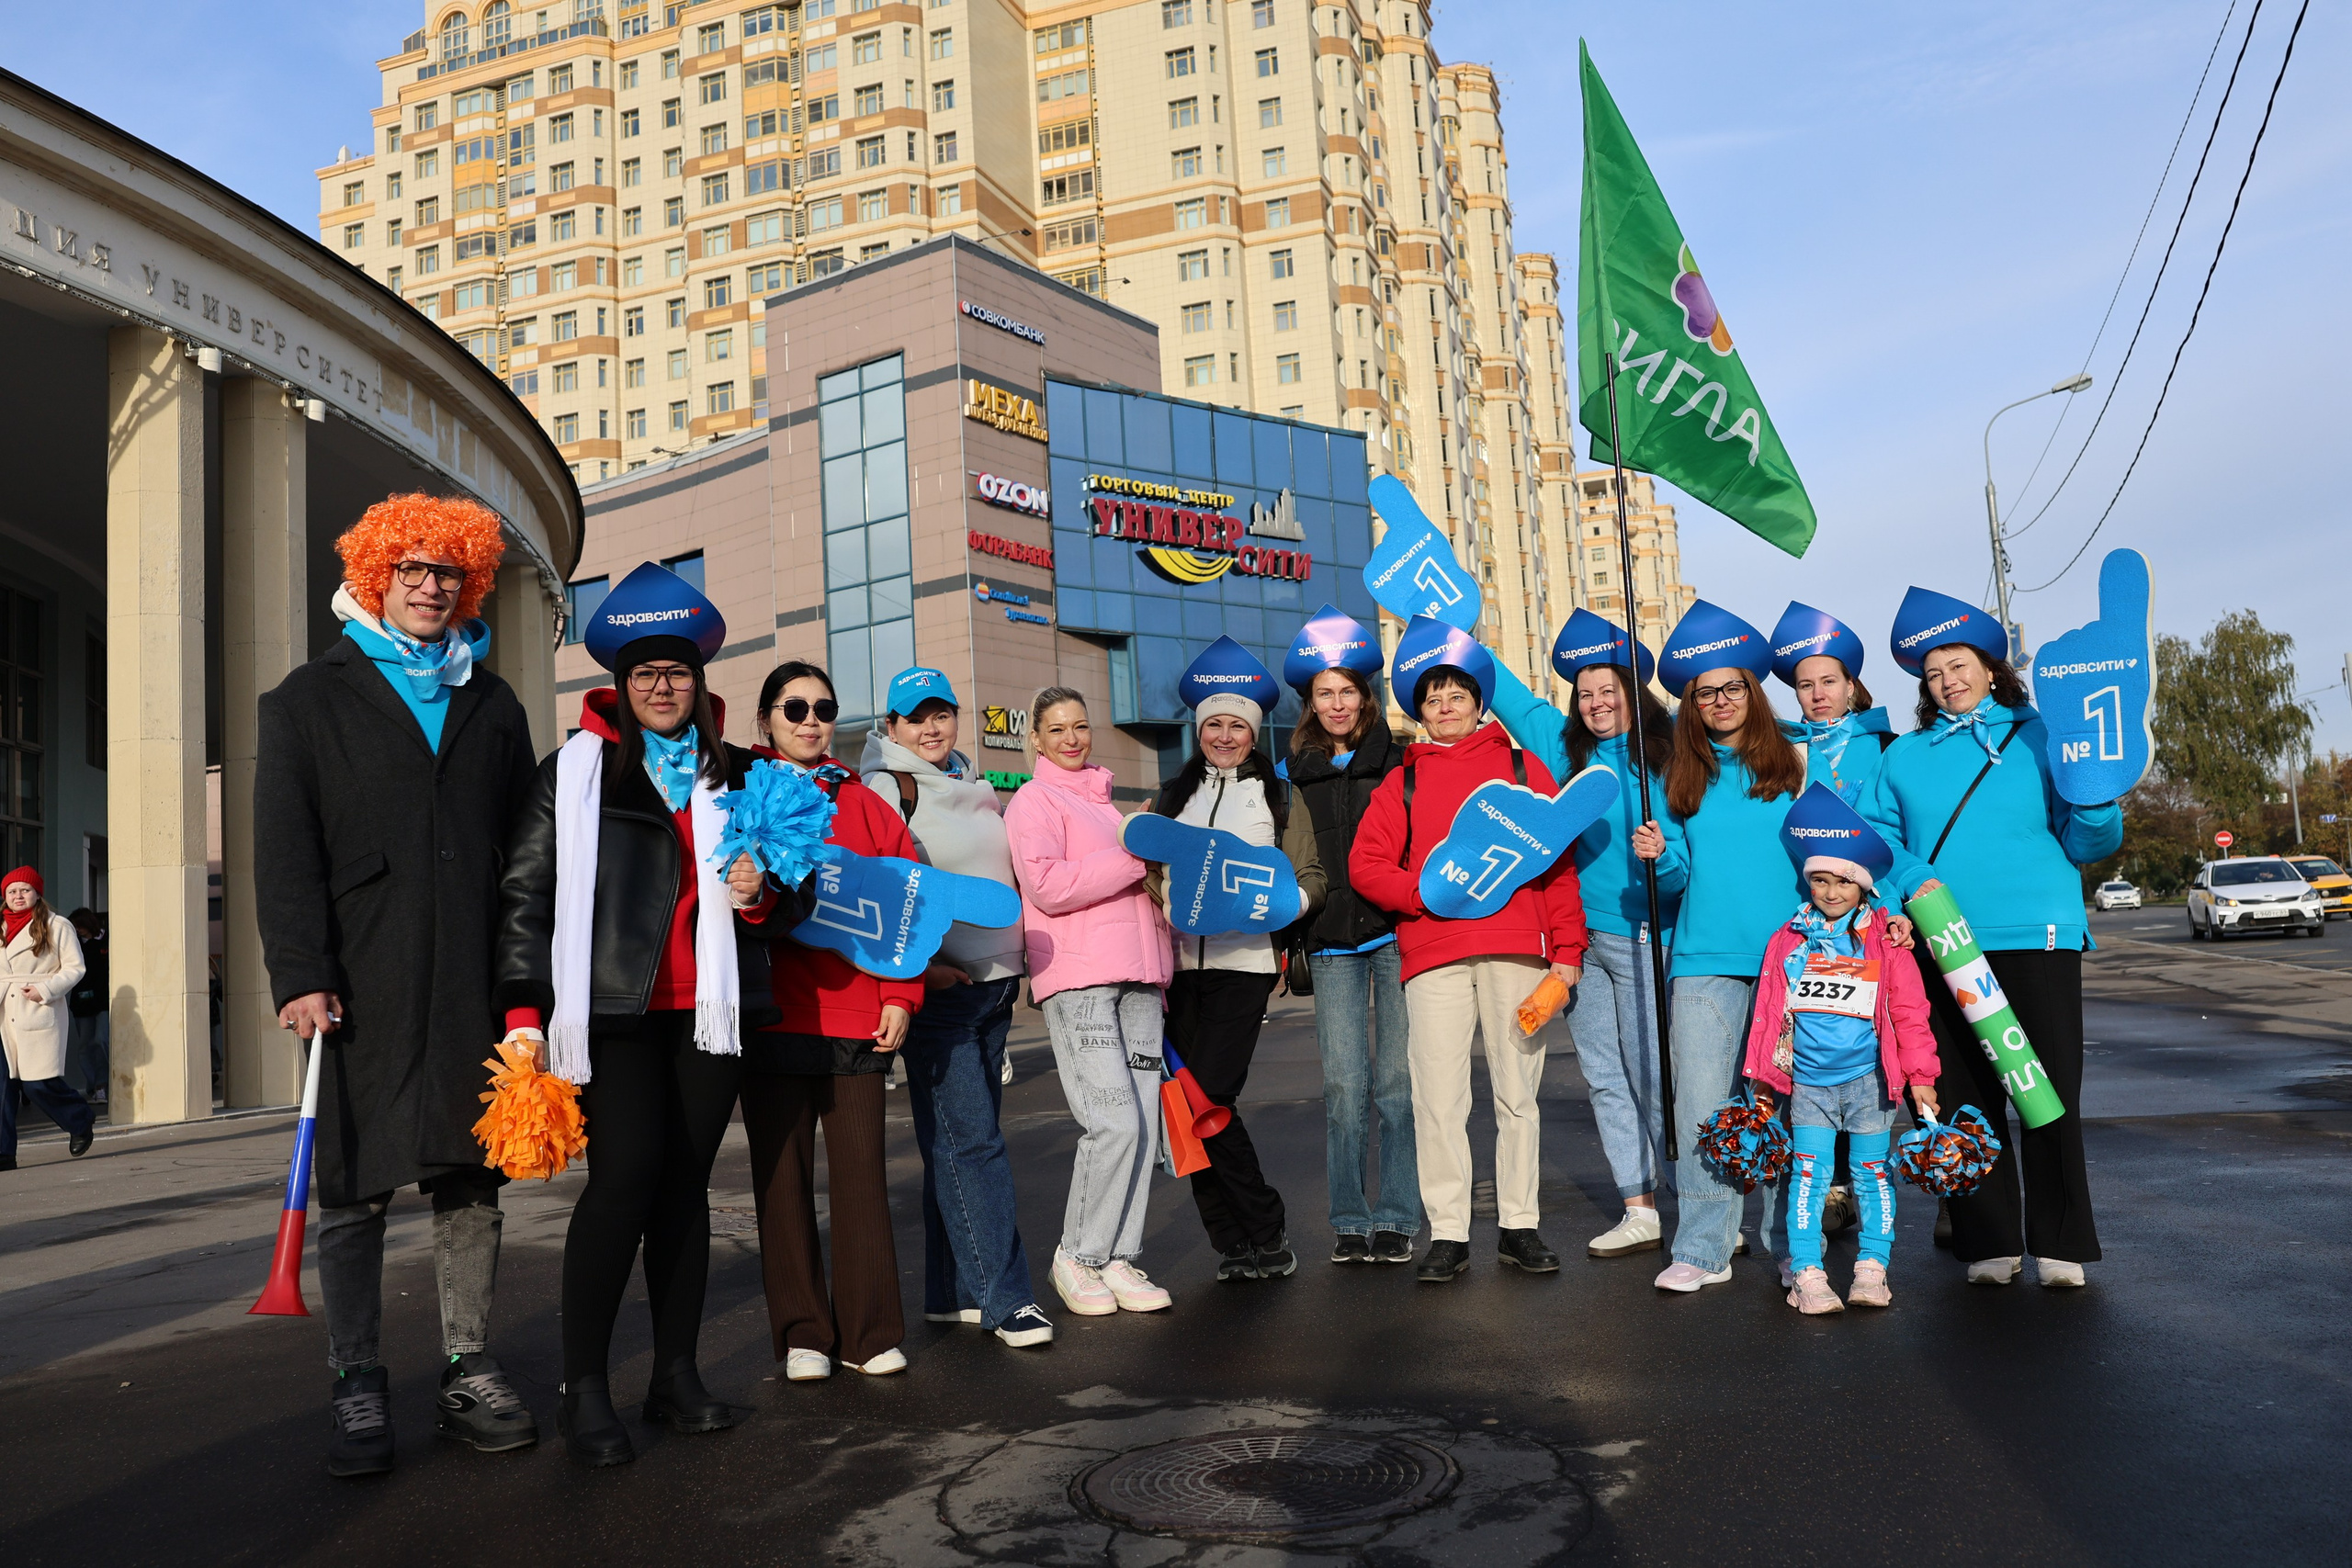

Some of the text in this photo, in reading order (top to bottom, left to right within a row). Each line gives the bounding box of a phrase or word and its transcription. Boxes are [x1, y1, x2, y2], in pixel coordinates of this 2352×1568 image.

[141, 263, 383, 413] УНИВЕРСИТЕТ
[971, 304, 1046, 344] СОВКОМБАНК
[968, 378, 1039, 426] МЕХА
[1613, 318, 1759, 467] ИГЛА
[978, 472, 1048, 515] OZON
[1090, 474, 1236, 507] ТОРГОВЫЙ ЦЕНТР
[1091, 497, 1244, 551] УНИВЕР
[1238, 545, 1312, 580] СИТИ
[1373, 538, 1426, 589] здравсити
[606, 608, 689, 626] здравсити
[1898, 617, 1961, 649] здравсити
[1298, 641, 1358, 657] здравсити
[1398, 642, 1453, 672] здравсити
[1559, 641, 1615, 660] здравсити
[1671, 637, 1739, 660] здравсити
[1775, 633, 1832, 657] здравсити
[898, 671, 936, 686] здравсити
[1193, 674, 1252, 685] здравсити
[2039, 660, 2124, 679] здравсити
[1477, 799, 1543, 851] здравсити
[1789, 827, 1849, 840] здравсити
[1188, 850, 1215, 927] здравсити
[894, 868, 922, 953] здравсити
[1798, 981, 1856, 1000] 3237
